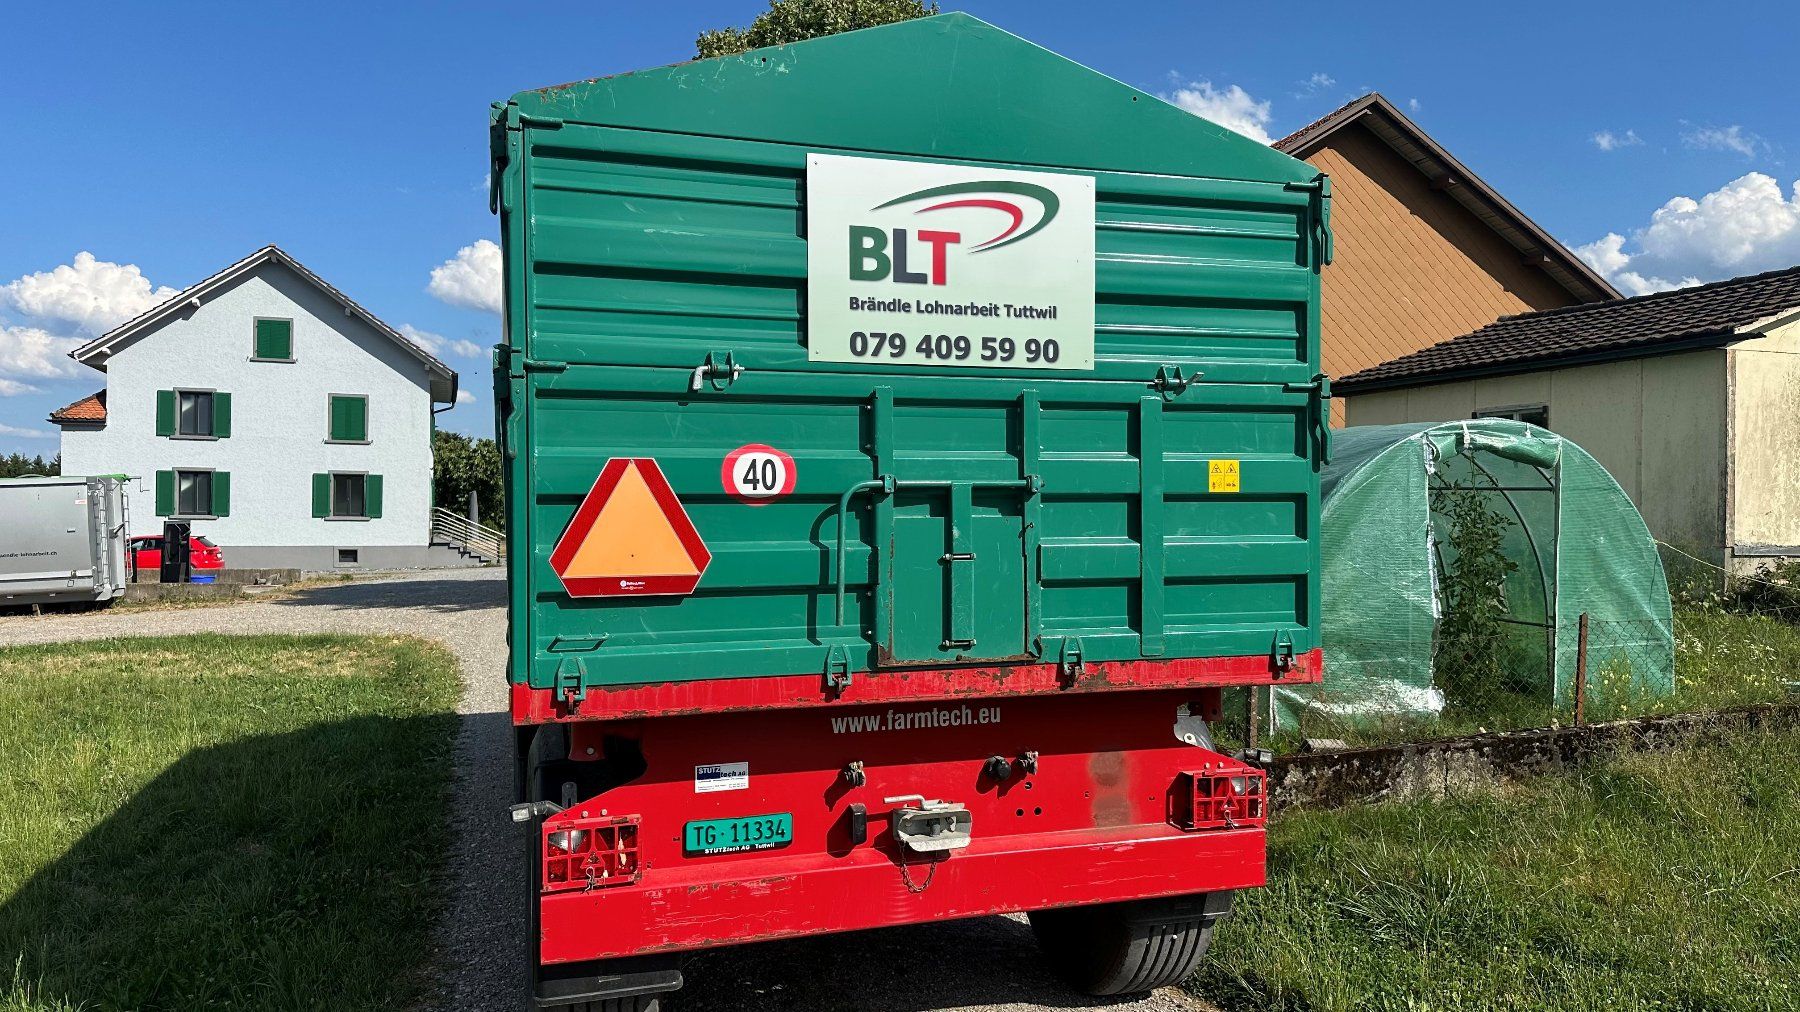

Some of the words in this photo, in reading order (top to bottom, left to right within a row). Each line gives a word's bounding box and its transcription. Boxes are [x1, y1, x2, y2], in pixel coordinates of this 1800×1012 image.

[849, 224, 961, 286] BLT
[849, 296, 911, 313] Brändle
[916, 300, 1000, 317] Lohnarbeit
[1003, 303, 1057, 320] Tuttwil
[849, 331, 906, 358] 079
[916, 334, 971, 360] 409
[980, 336, 1016, 362] 59
[1024, 338, 1060, 363] 90
[742, 458, 777, 491] 40
[831, 704, 1001, 734] www.farmtech.eu
[698, 766, 720, 774] STUTZ
